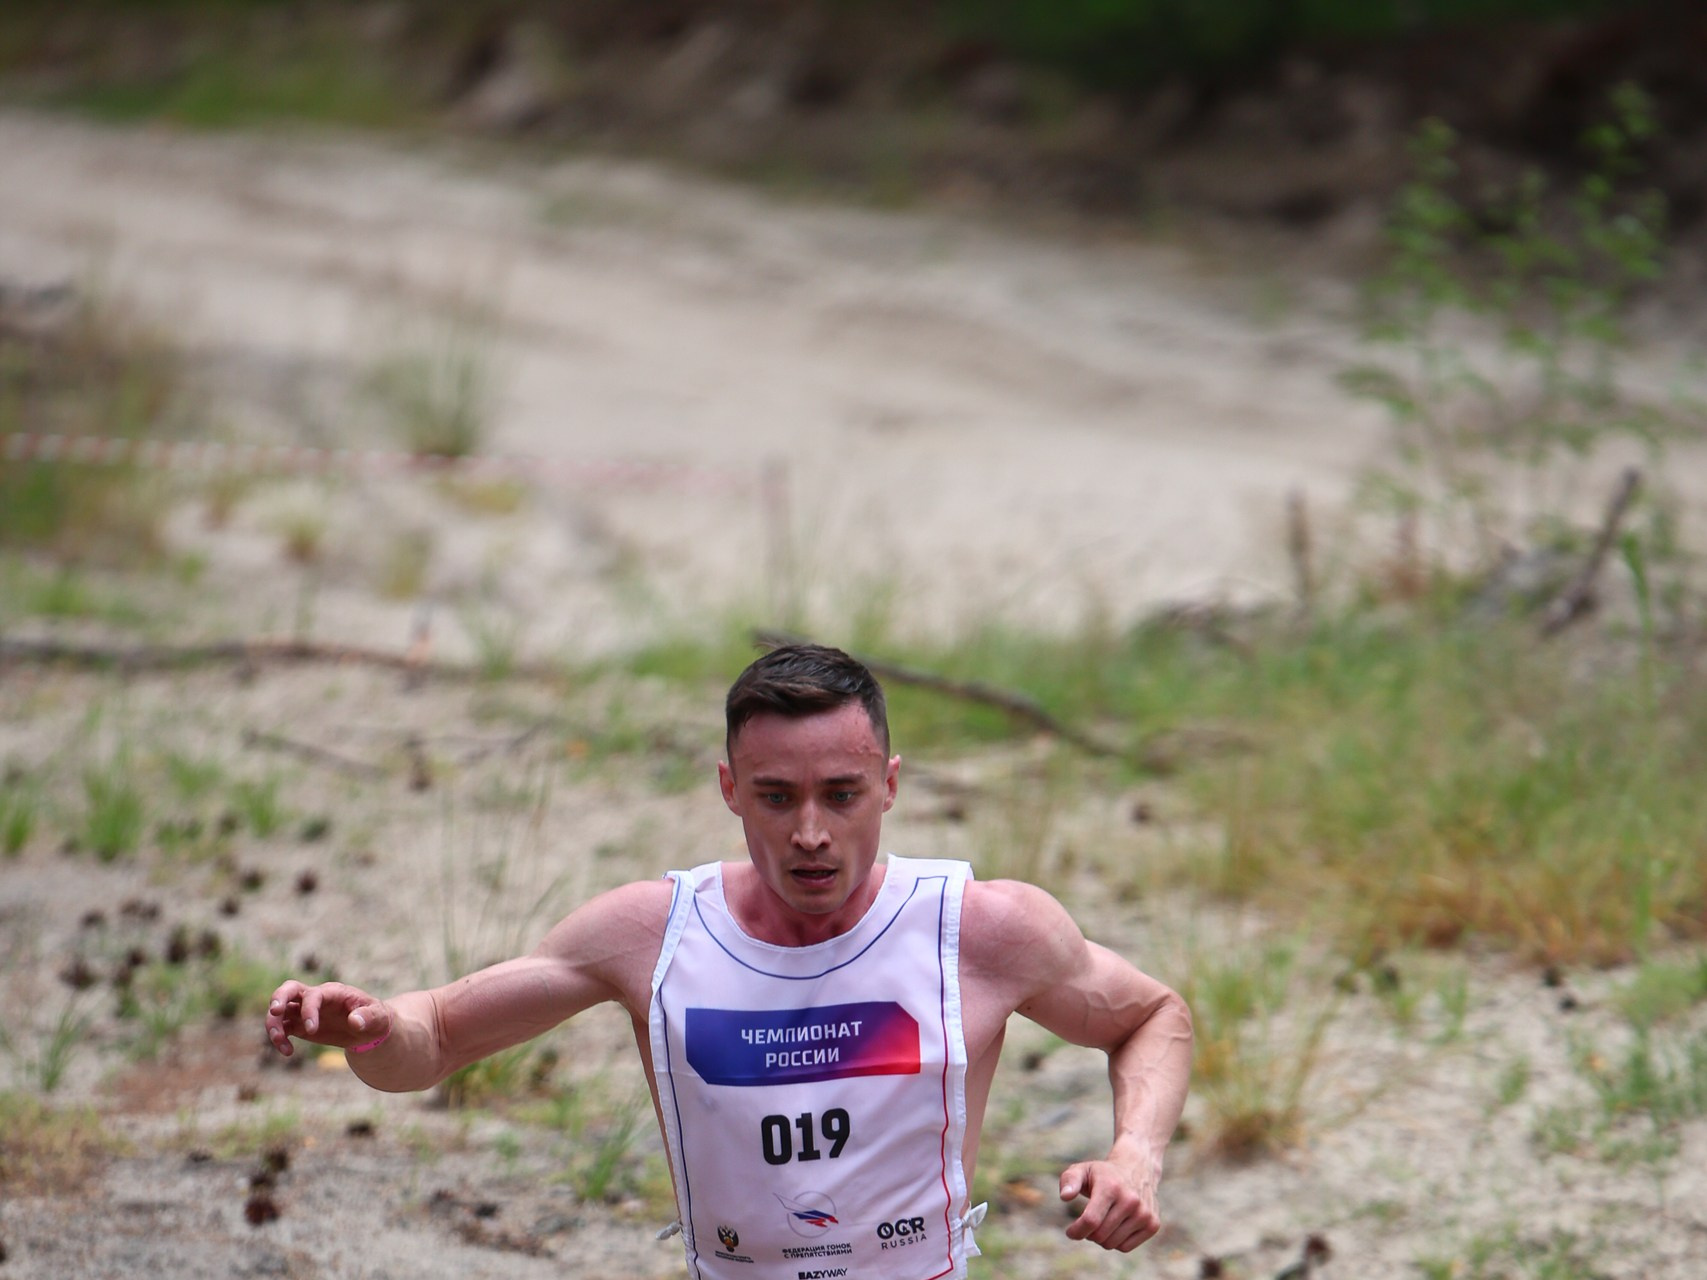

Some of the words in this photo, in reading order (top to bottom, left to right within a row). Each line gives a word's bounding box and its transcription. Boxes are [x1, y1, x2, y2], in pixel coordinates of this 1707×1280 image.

[741, 1020, 863, 1045] ЧЕМПИОНАТ
[765, 1047, 840, 1068] РОССИИ
[761, 1107, 850, 1166] 019
[876, 1216, 925, 1240] OCR
[782, 1245, 825, 1253] ФЕДЕРАЦИЯ
[827, 1242, 851, 1250] ГОНОК
[881, 1233, 927, 1250] RUSSIA
